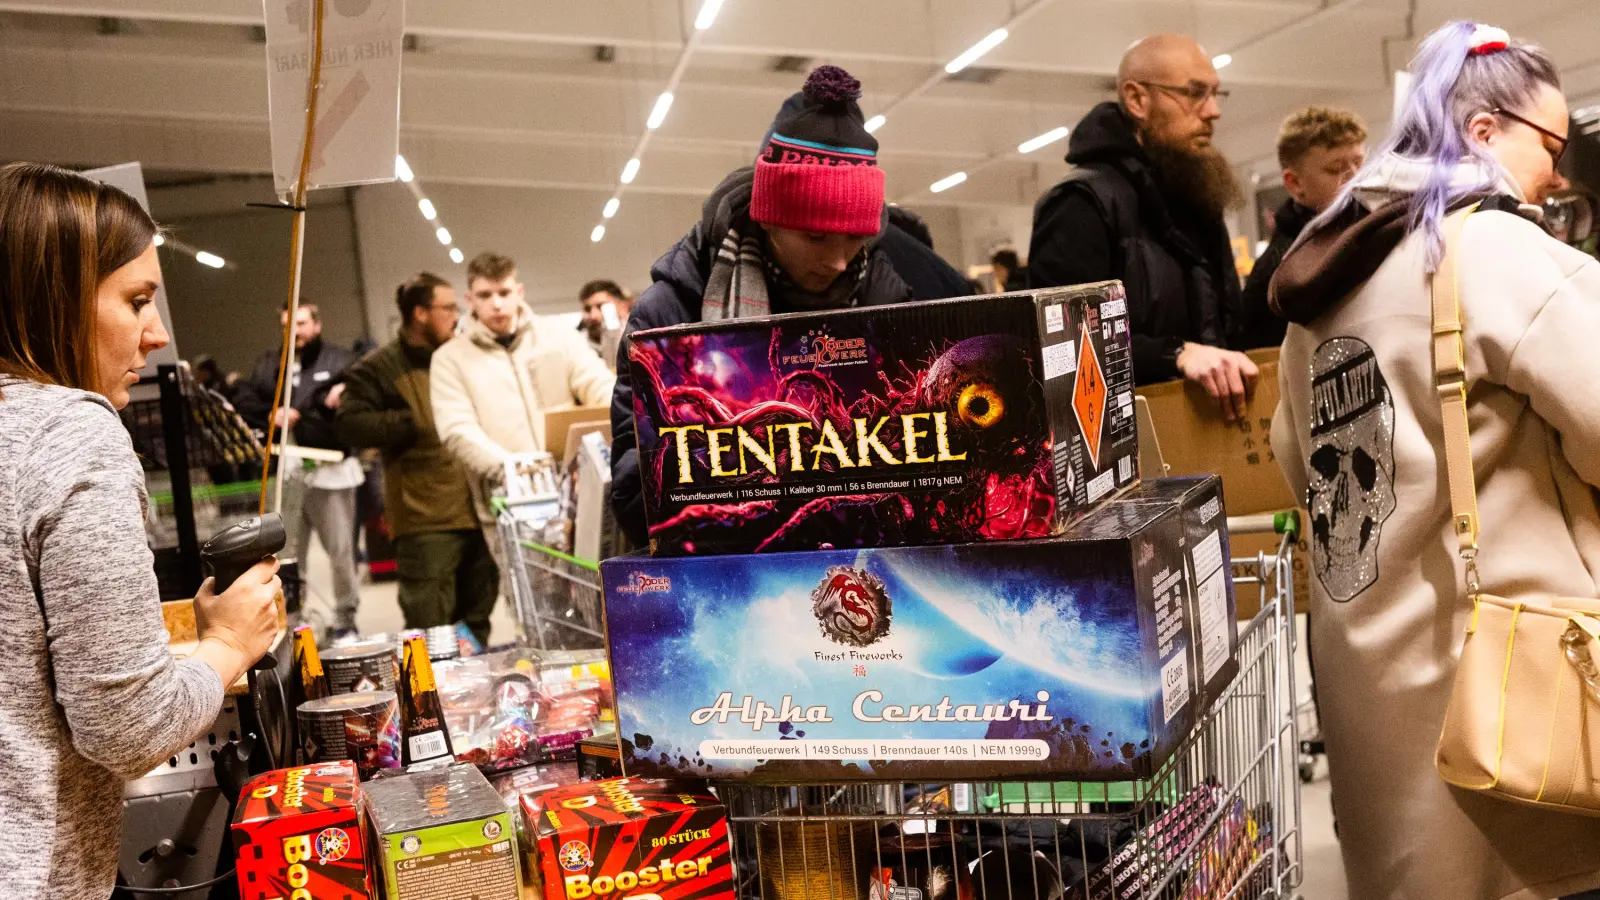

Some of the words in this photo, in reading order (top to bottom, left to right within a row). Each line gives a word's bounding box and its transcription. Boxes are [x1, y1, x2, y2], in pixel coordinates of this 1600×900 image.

[1082, 362, 1096, 396] 1.4
[1312, 356, 1377, 428] PULARITY
[1088, 402, 1094, 423] G
[658, 411, 967, 484] TENTAKEL
[670, 490, 733, 502] Verbundfeuerwerk
[741, 489, 754, 498] 116
[755, 487, 782, 497] Schuss
[790, 484, 814, 494] Kaliber
[816, 484, 826, 493] 30
[827, 484, 843, 492] mm
[849, 482, 859, 490] 56
[867, 479, 910, 489] Brenndauer
[943, 475, 963, 484] NEM
[814, 651, 846, 662] Finest
[849, 649, 903, 661] Fireworks
[853, 664, 867, 677] 福
[690, 692, 834, 731] Alpha
[851, 689, 1054, 723] Centauri
[712, 745, 801, 755] Verbundfeuerwerk
[812, 745, 830, 755] 149
[831, 745, 869, 755] Schuss
[880, 745, 941, 755] Brenndauer
[943, 745, 968, 755] 140s
[980, 745, 1006, 755] NEM
[1009, 745, 1042, 758] 1999g
[282, 768, 311, 807] Booster
[596, 779, 647, 813] Booster
[651, 837, 668, 848] 80
[669, 829, 711, 845] STÜCK
[565, 855, 713, 899] Booster
